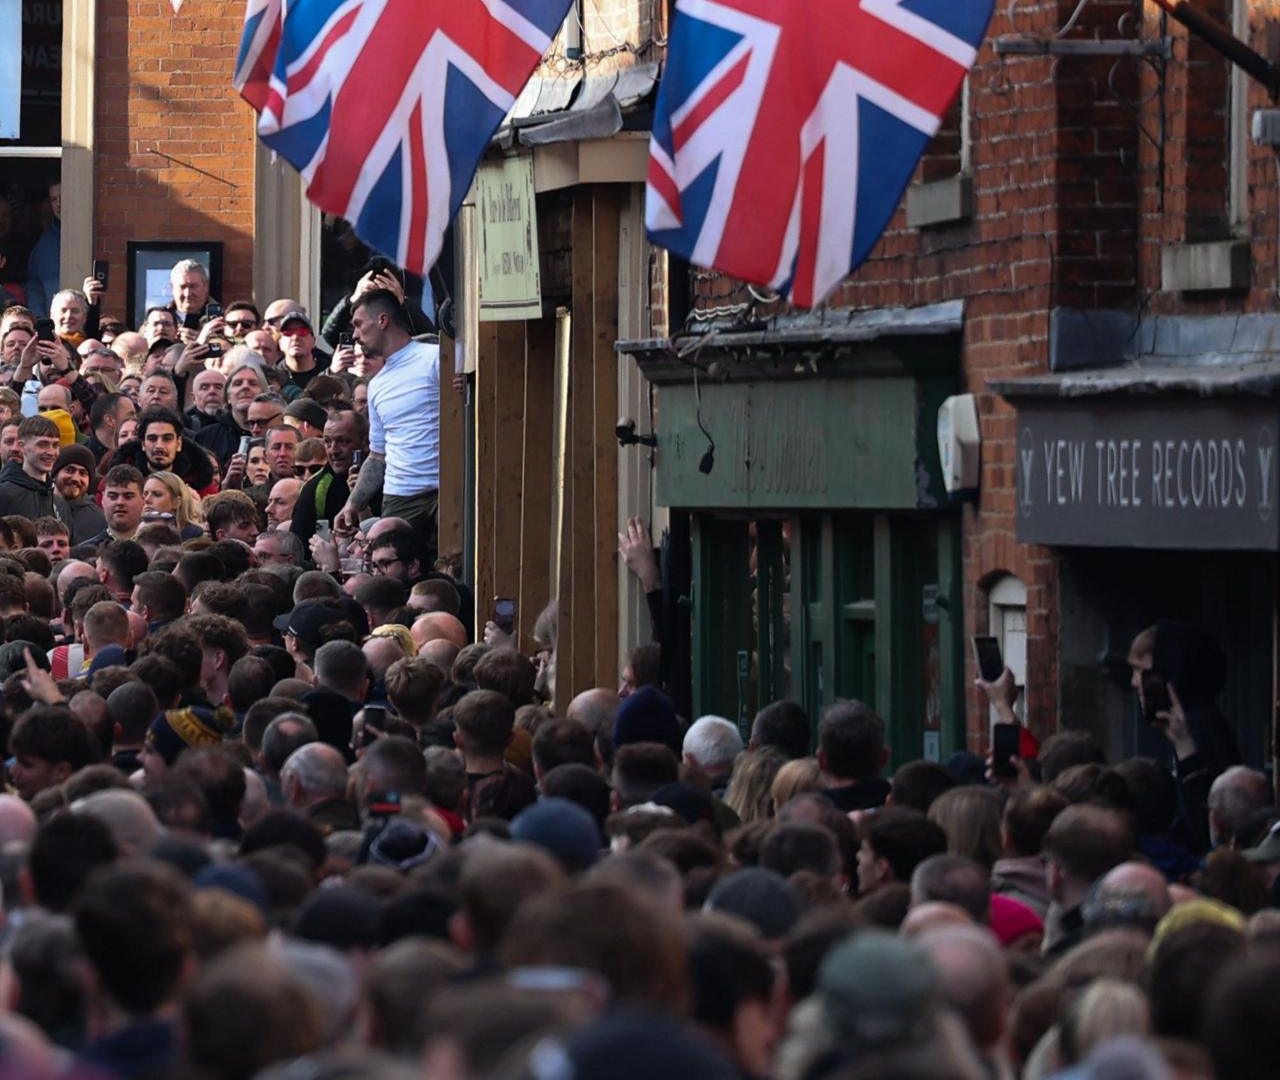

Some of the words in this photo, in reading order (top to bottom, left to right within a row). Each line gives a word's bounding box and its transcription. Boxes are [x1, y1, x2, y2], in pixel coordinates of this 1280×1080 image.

[1044, 440, 1085, 505] YEW
[1095, 439, 1141, 506] TREE
[1152, 438, 1247, 508] RECORDS
